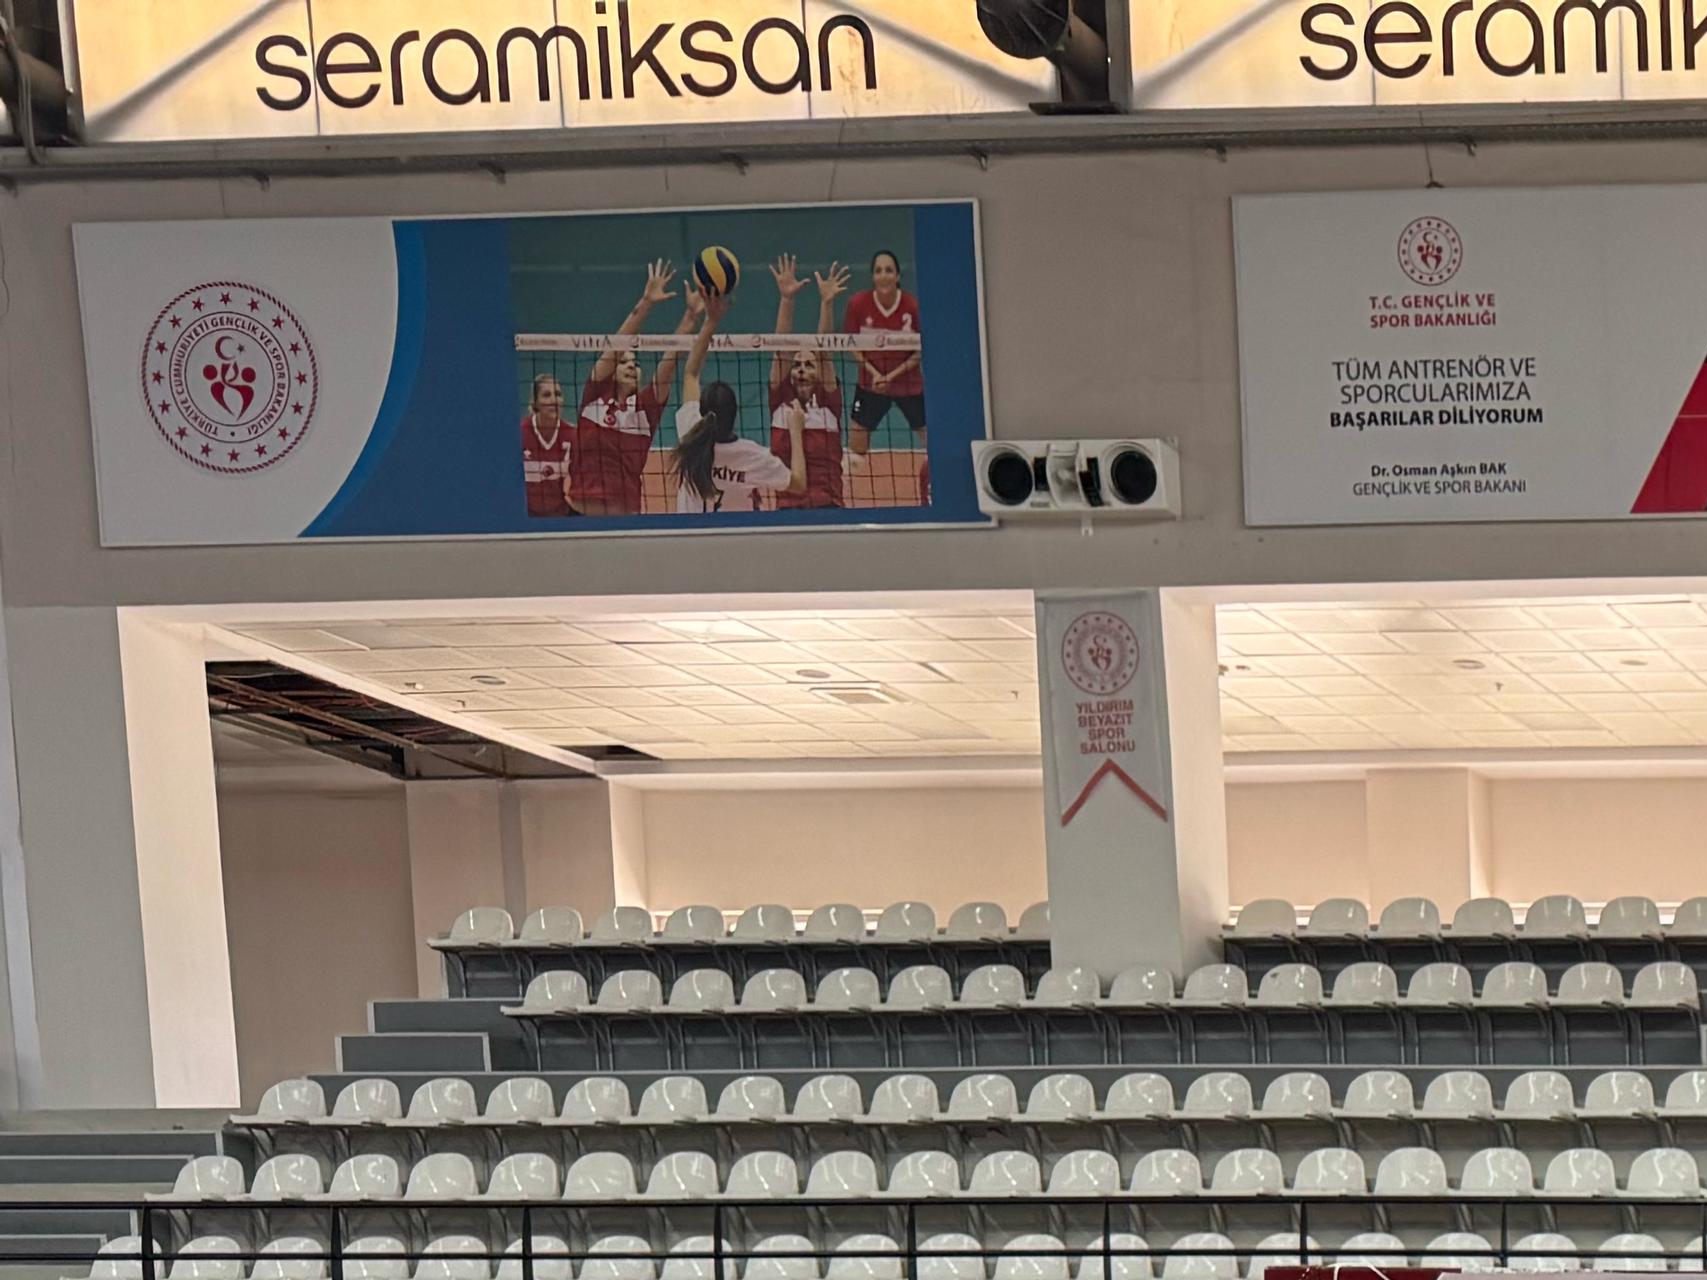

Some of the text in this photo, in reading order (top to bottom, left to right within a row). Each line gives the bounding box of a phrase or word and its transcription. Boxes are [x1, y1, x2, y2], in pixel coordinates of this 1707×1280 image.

[255, 2, 877, 111] seramiksan
[1369, 292, 1496, 311] T.C. GENÇLİK VE
[1370, 310, 1497, 329] SPOR BAKANLIĞI
[259, 330, 273, 346] VE
[1332, 355, 1537, 382] TÜM ANTRENÖR VE
[1340, 381, 1532, 405] SPORCULARIMIZA
[1329, 405, 1544, 431] BAŞARILAR DİLİYORUM
[1371, 462, 1507, 478] Dr. Osman Aşkın BAK
[1353, 479, 1527, 498] GENÇLİK VE SPOR BAKANI
[1075, 699, 1135, 715] YILDIRIM
[1077, 713, 1135, 729] BEYAZIT
[1087, 727, 1126, 742] SPOR
[1079, 740, 1137, 756] SALONU
